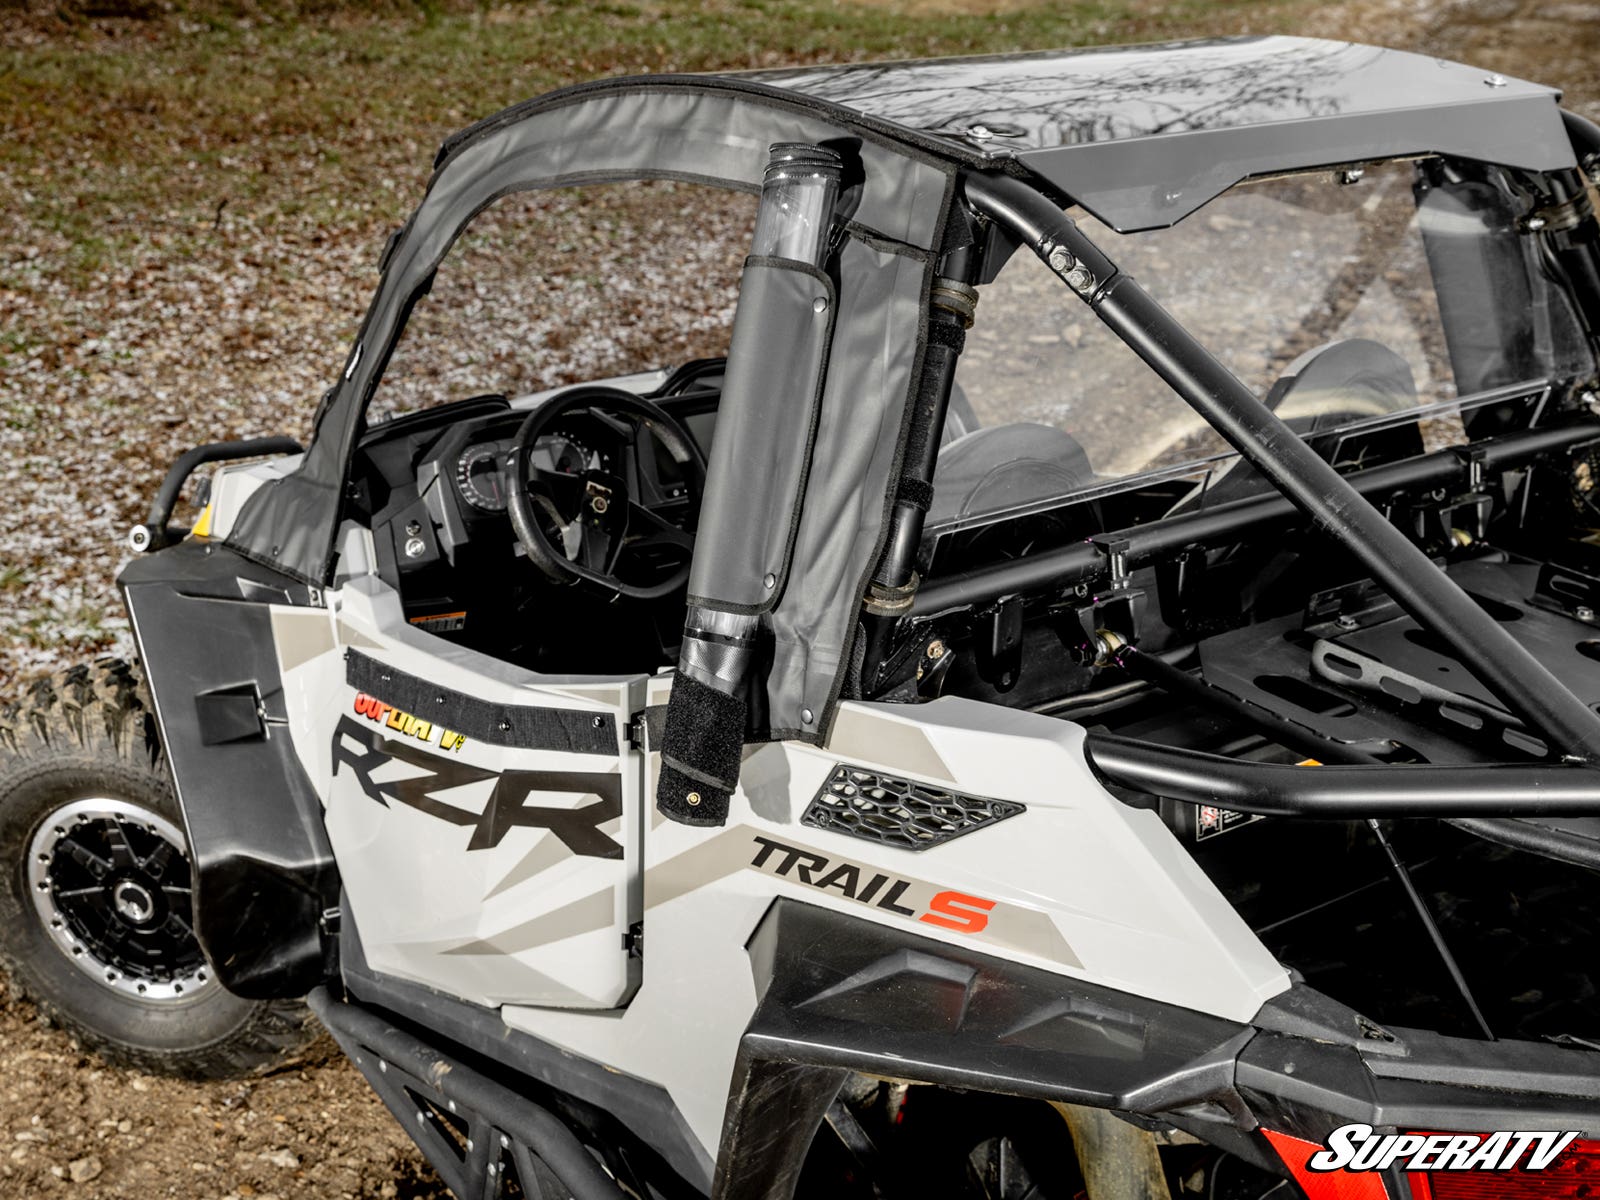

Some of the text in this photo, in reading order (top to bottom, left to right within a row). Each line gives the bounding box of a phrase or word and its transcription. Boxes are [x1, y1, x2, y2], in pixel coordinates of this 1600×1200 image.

[332, 714, 624, 860] RZR
[751, 836, 997, 934] TRAIL S
